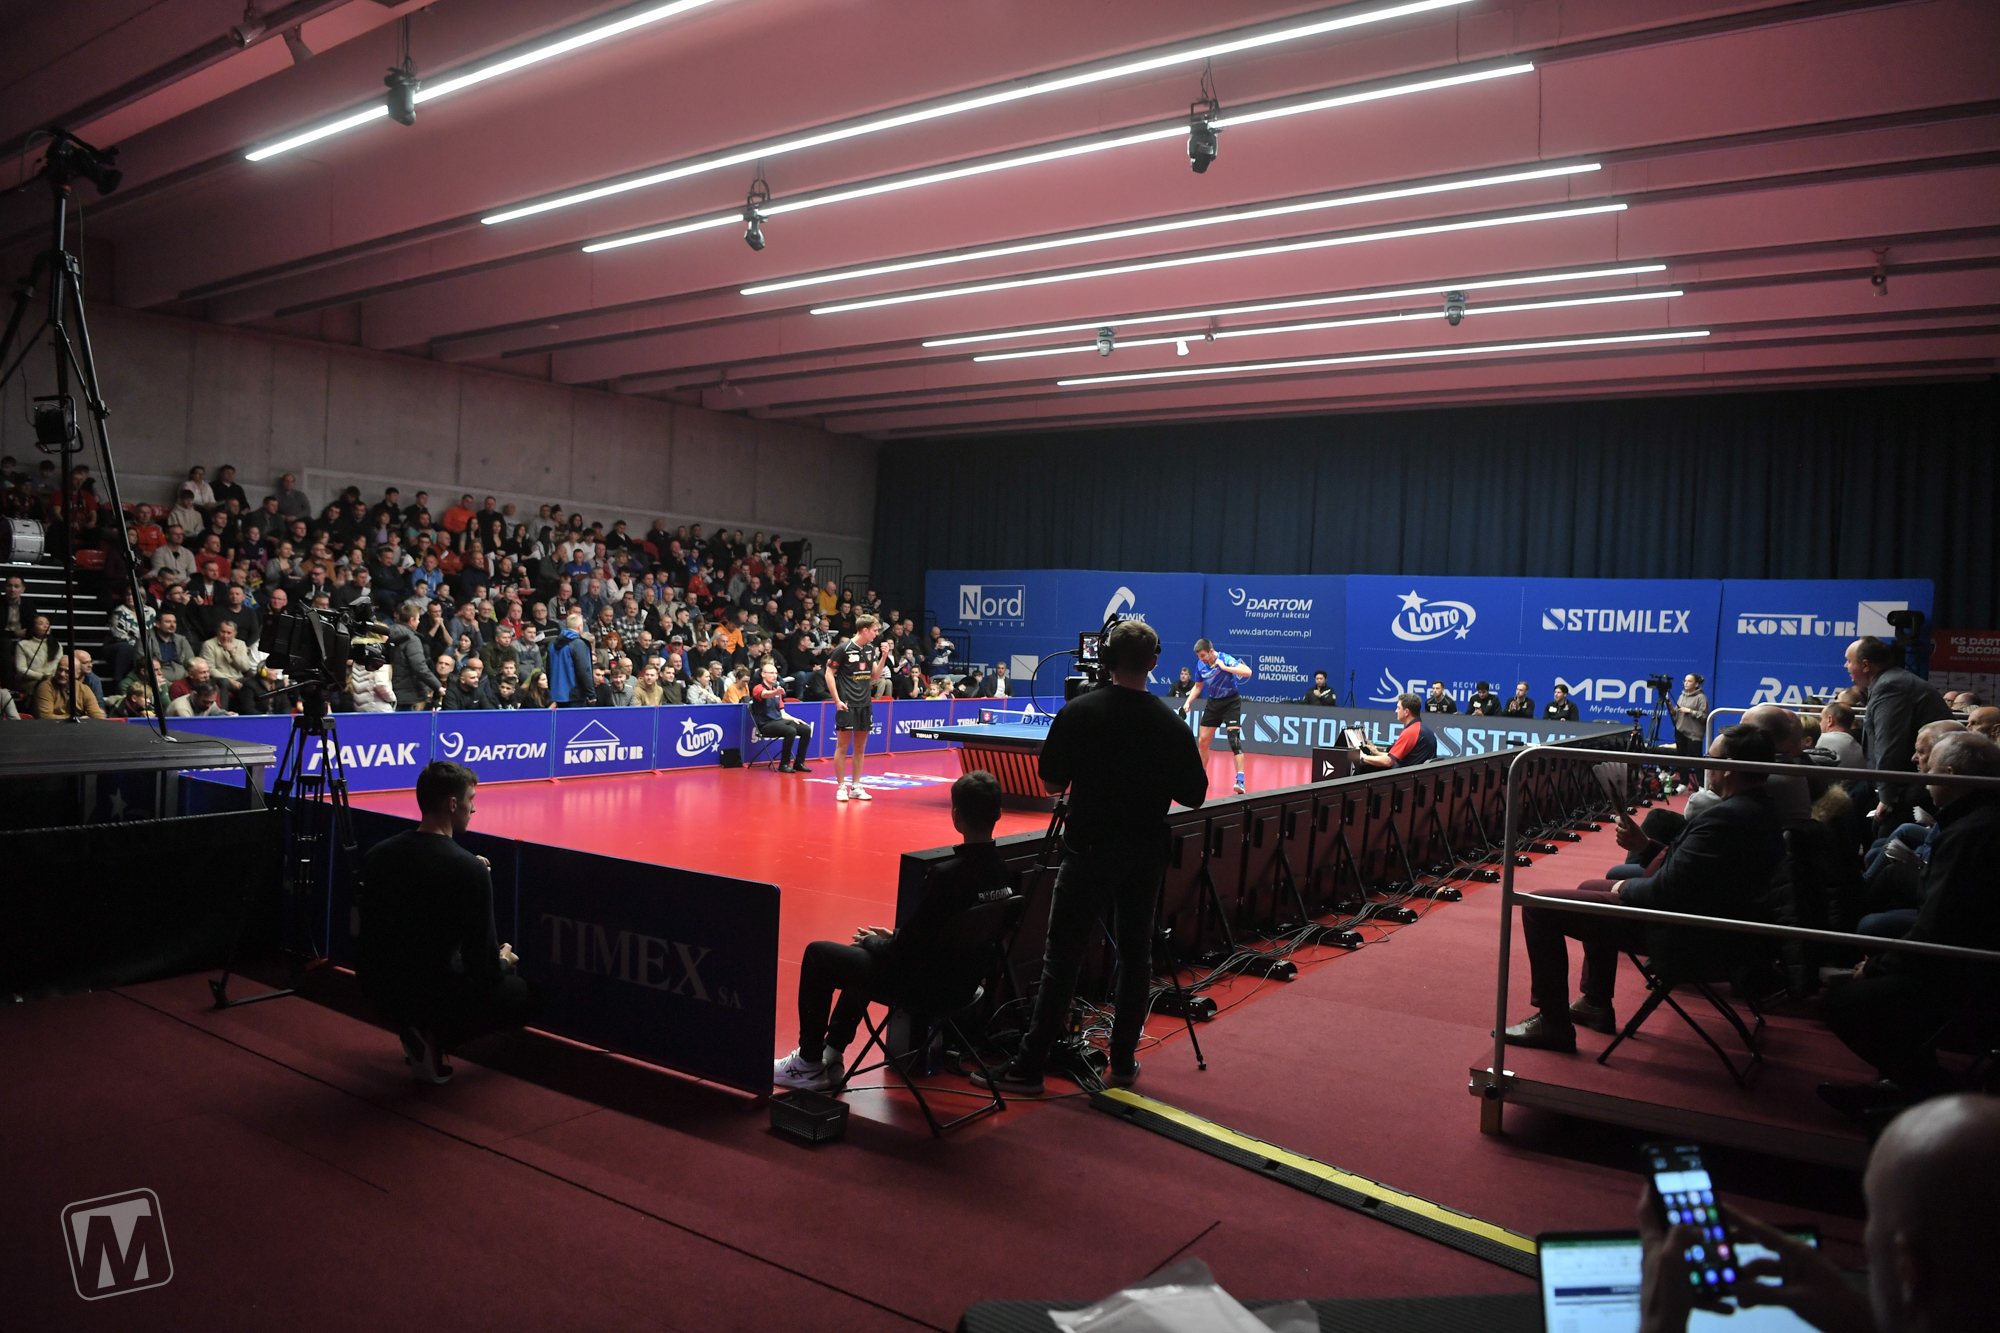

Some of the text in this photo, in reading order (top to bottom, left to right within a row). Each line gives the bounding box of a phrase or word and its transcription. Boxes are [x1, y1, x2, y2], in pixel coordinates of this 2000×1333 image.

[962, 589, 1022, 616] Nord
[1246, 598, 1313, 611] DARTOM
[1245, 610, 1310, 619] Transport sukcesu
[1408, 609, 1460, 633] LOTTO
[1567, 608, 1691, 634] STOMILEX
[1229, 628, 1312, 638] www.dartom.com.pl
[1950, 636, 1967, 645] KS
[1259, 655, 1285, 664] GMINA
[1258, 664, 1298, 673] GRODZISK
[1258, 672, 1309, 682] MAZOWIECKI
[1453, 681, 1501, 690] RECYNG
[1589, 704, 1602, 714] My
[685, 729, 715, 750] LOTTO
[307, 739, 418, 770] RAVAK
[464, 742, 547, 762] DARTOM
[541, 912, 742, 1010] TIMEX SA
